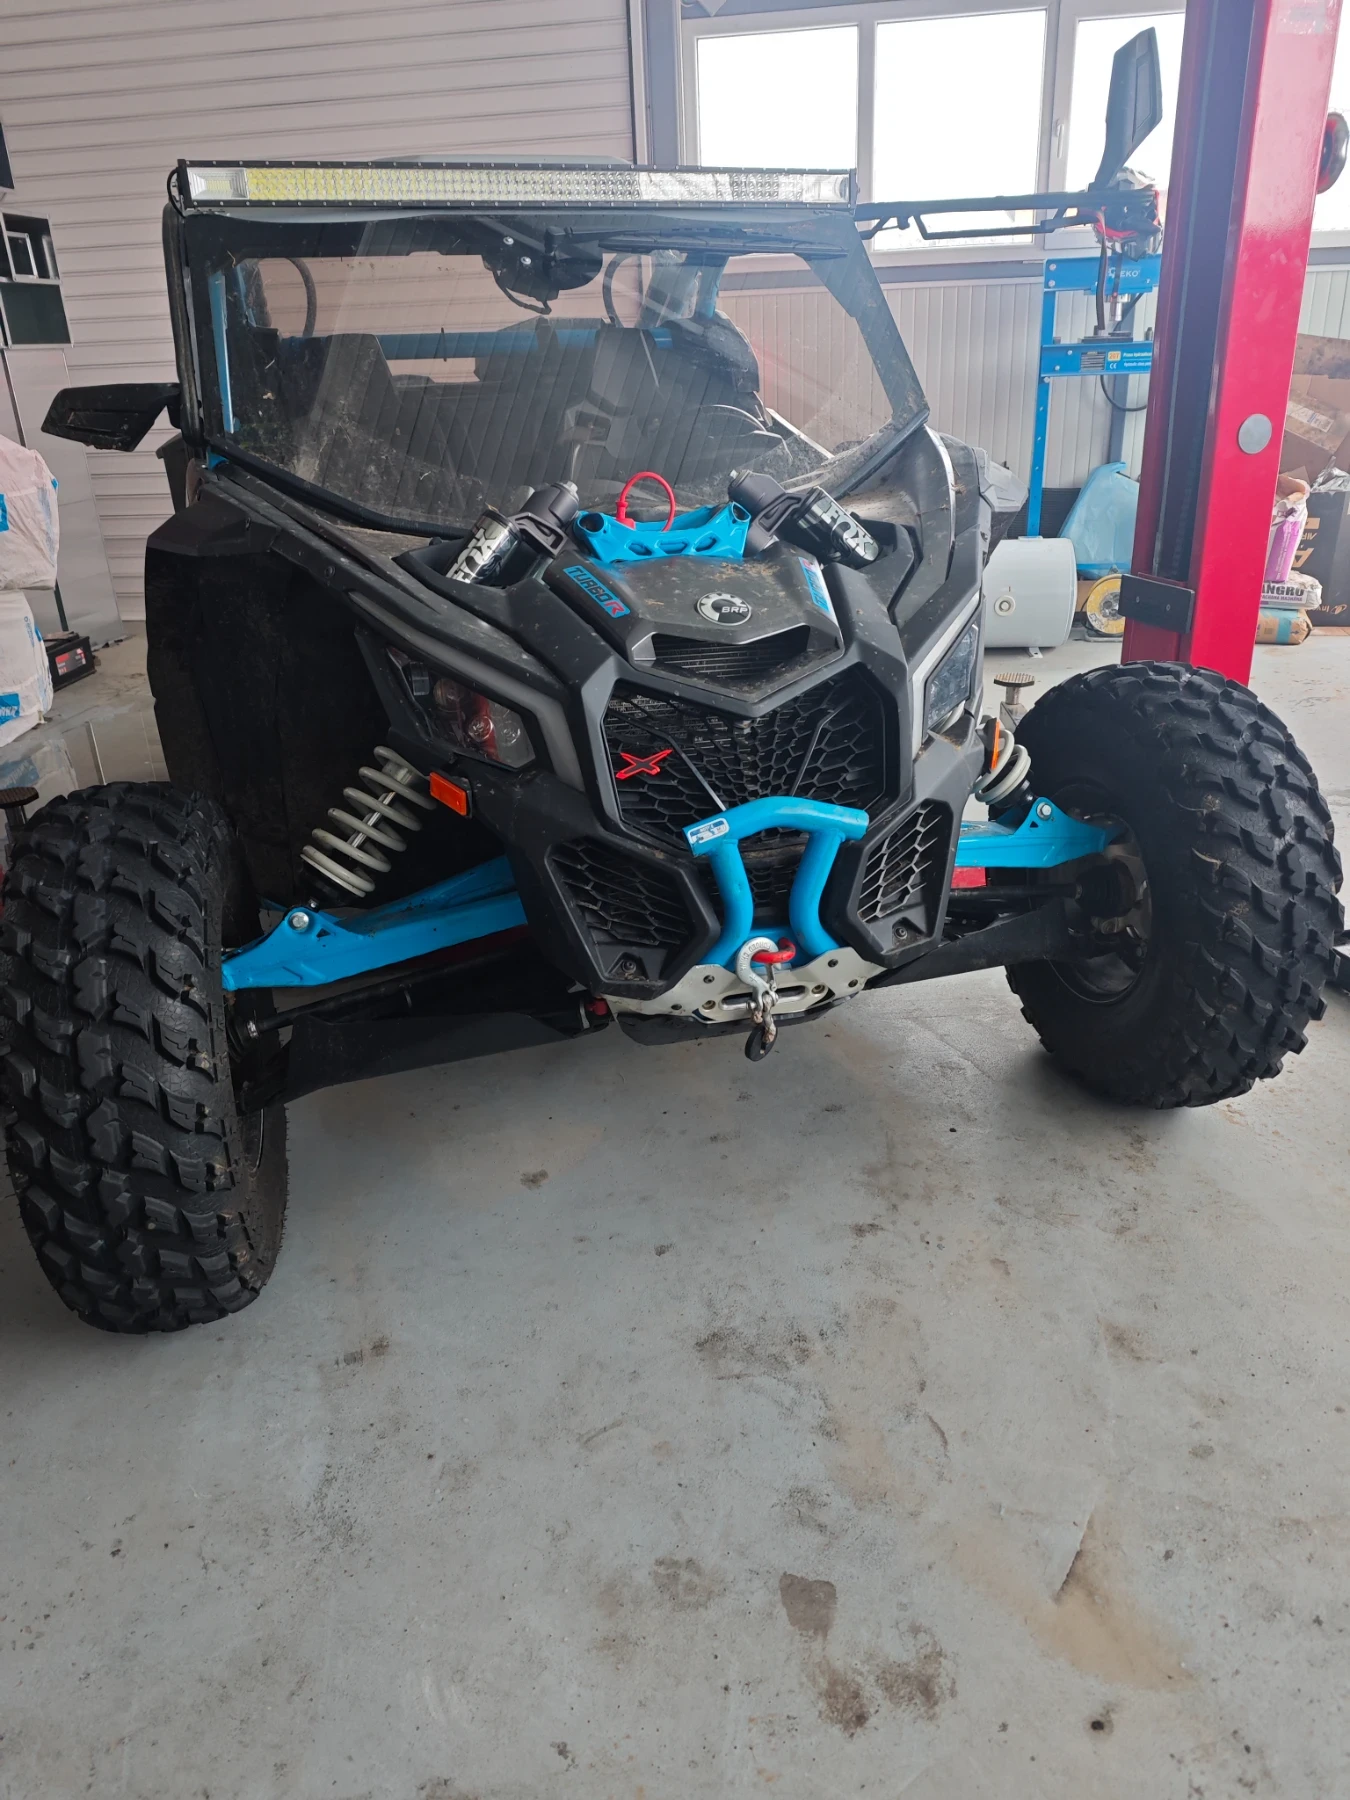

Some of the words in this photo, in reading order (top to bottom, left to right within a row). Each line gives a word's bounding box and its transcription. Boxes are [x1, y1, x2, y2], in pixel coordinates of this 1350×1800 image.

[446, 527, 497, 584] FOX
[820, 500, 879, 561] FOX
[721, 606, 748, 614] BRP
